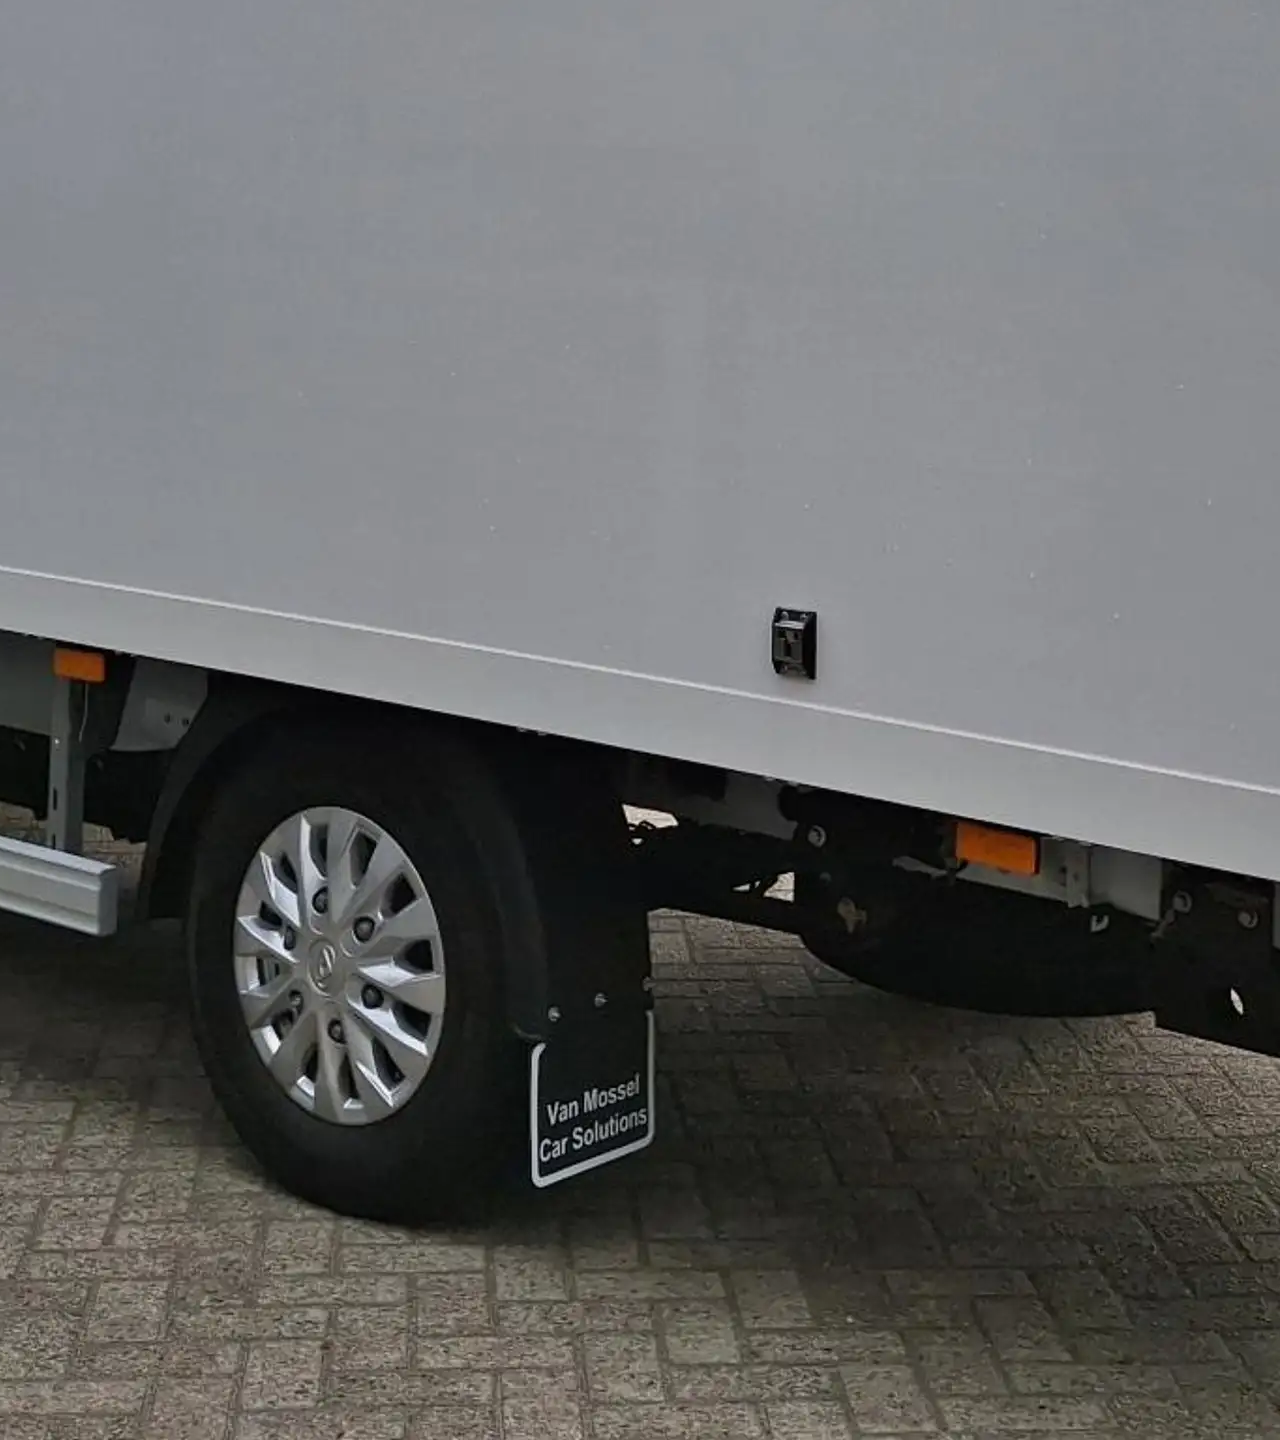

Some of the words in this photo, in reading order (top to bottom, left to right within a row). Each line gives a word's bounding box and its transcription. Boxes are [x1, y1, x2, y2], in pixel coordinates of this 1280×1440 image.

[547, 1101, 579, 1126] Van
[583, 1072, 640, 1113] Mossel
[540, 1137, 569, 1162] Car
[572, 1108, 647, 1150] Solutions
